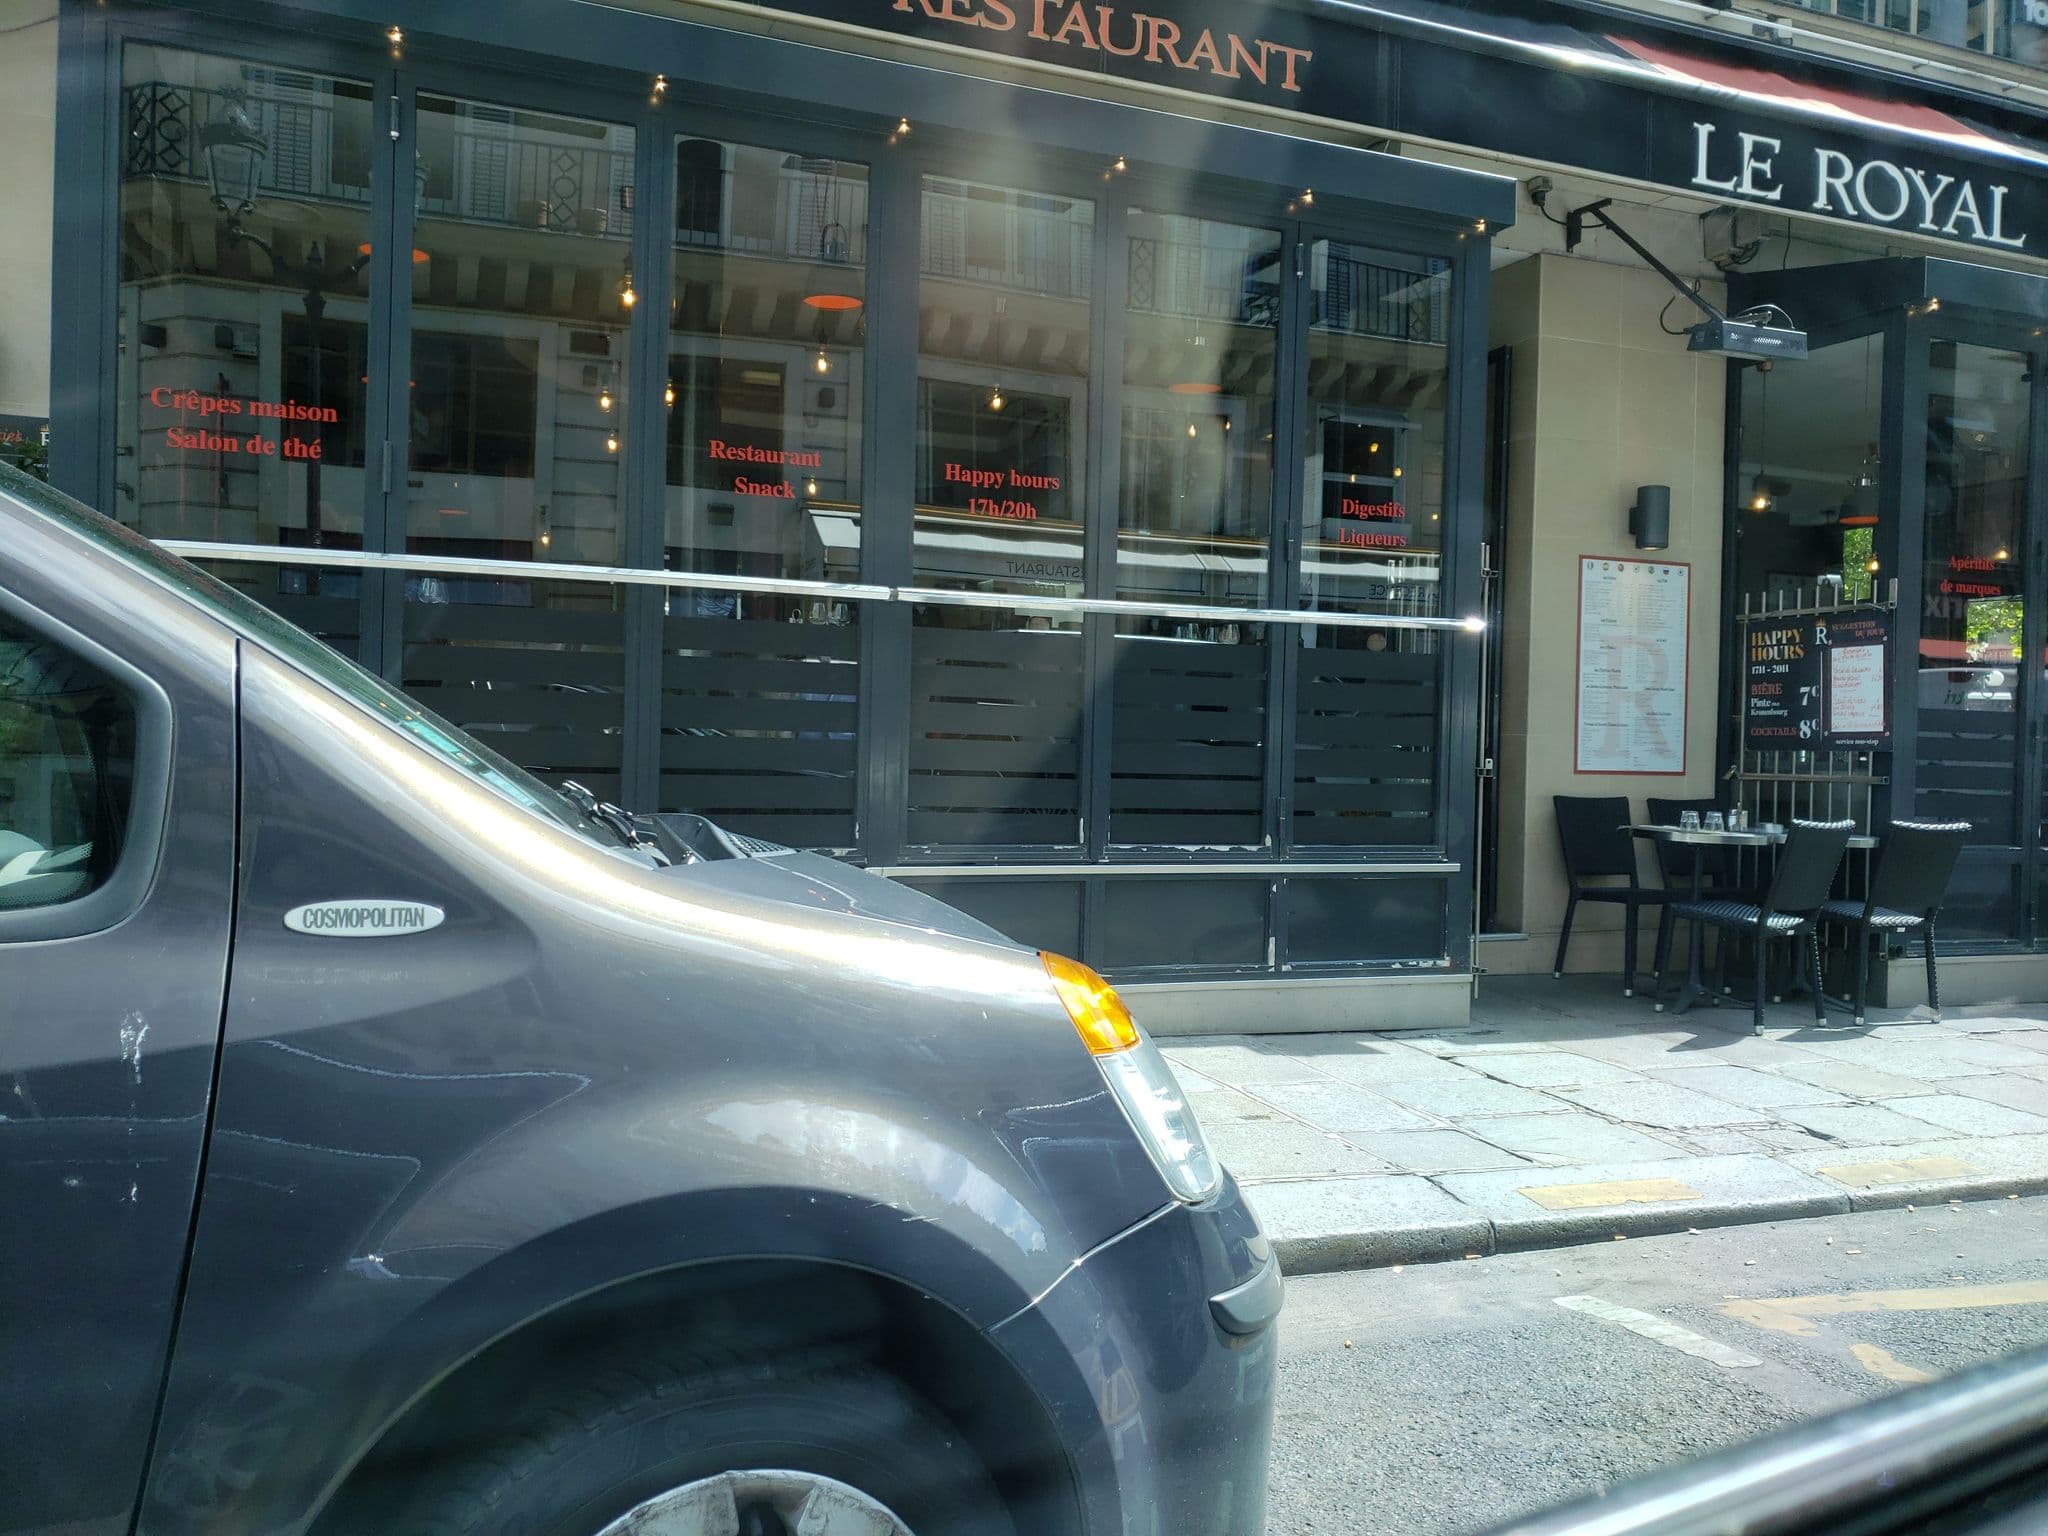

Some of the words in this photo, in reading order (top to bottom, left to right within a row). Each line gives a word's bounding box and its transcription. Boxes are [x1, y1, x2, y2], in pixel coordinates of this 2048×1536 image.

[1692, 122, 1784, 200] LE
[1813, 148, 2027, 247] ROYAL
[150, 387, 241, 417] Crêpes
[248, 400, 338, 423] maison
[166, 427, 239, 453] Salon
[245, 434, 276, 456] de
[283, 438, 322, 460] thé
[708, 440, 822, 468] Restaurant
[944, 464, 1004, 488] Happy
[1010, 468, 1061, 490] hours
[734, 476, 797, 499] Snack
[967, 498, 1038, 520] 17h/20h
[1342, 499, 1406, 519] Digestifs
[1338, 528, 1407, 547] Liqueurs
[1948, 556, 1996, 571] Apéritifs
[1940, 579, 1953, 593] de
[1955, 582, 2001, 597] marques
[1752, 629, 1803, 646] HAPPY
[1815, 626, 1828, 645] R
[1752, 645, 1805, 661] HOURS
[1751, 682, 1783, 695] BIÈRE
[1751, 698, 1771, 707] Pinte
[1751, 727, 1797, 736] COCKTAILS
[303, 908, 425, 928] COSMOPOLITAN
